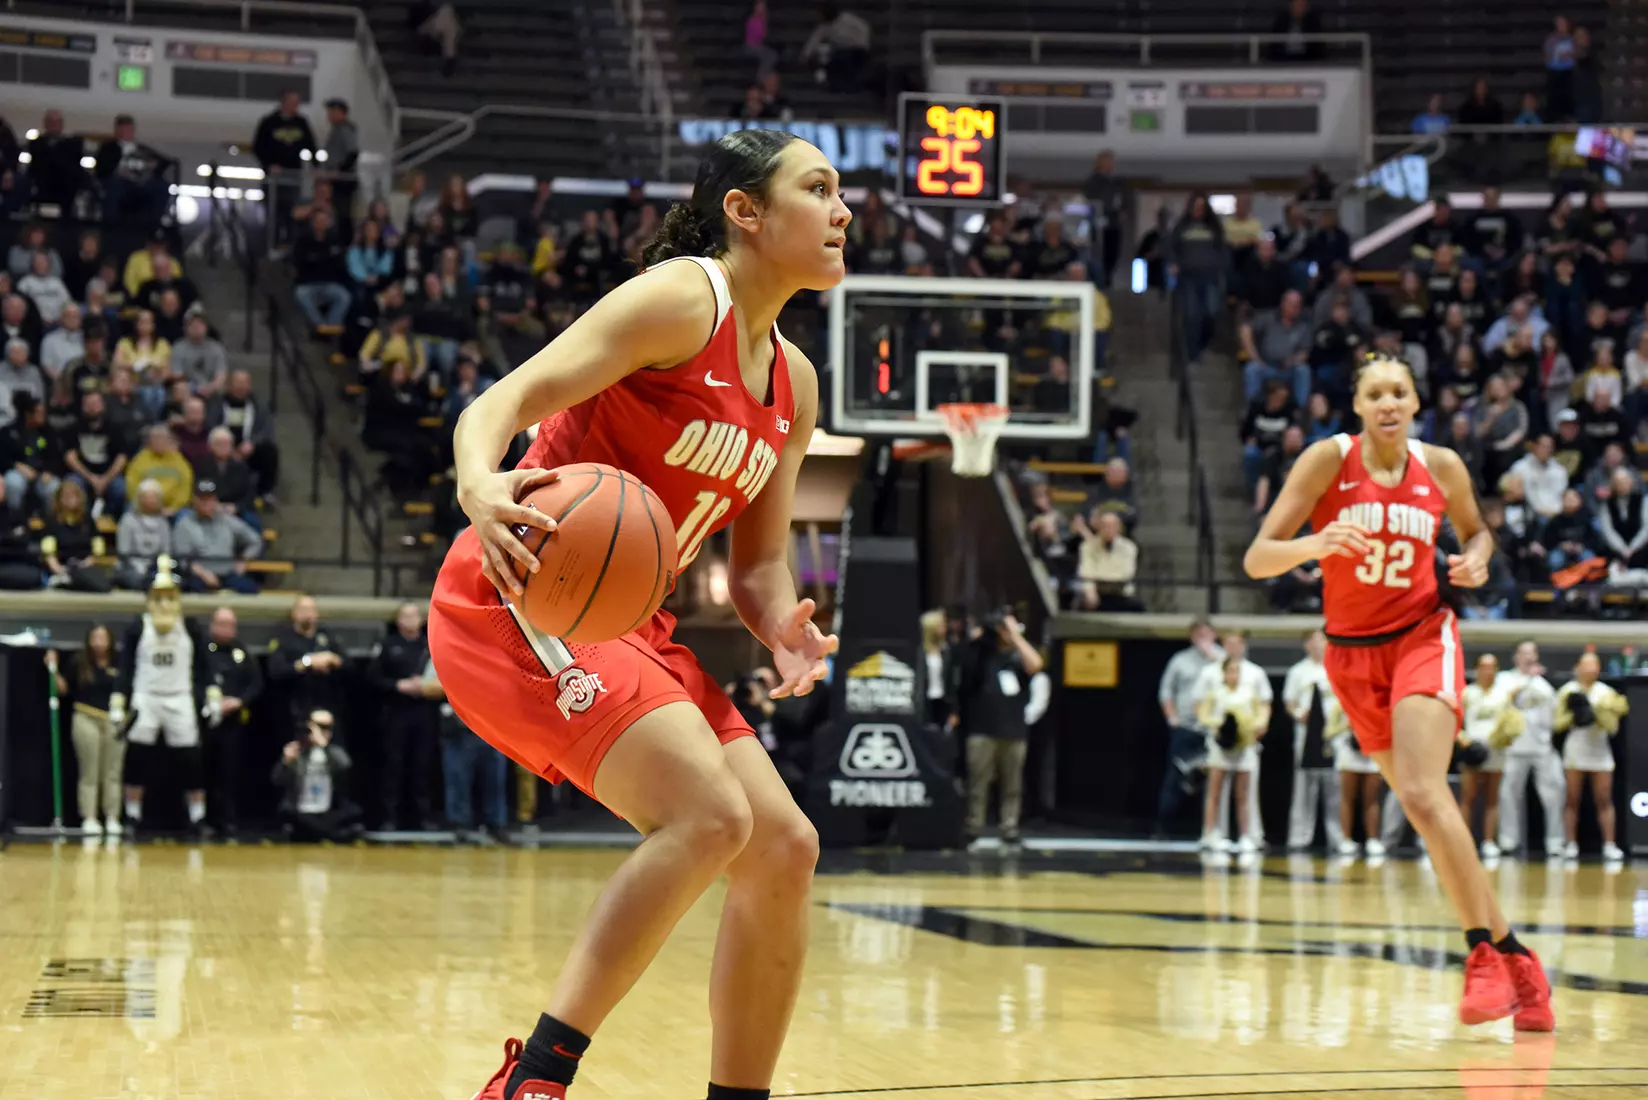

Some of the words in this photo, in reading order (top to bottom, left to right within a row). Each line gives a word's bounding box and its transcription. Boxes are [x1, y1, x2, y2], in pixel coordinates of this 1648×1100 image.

[926, 106, 995, 139] 9:04
[918, 137, 984, 195] 25
[664, 419, 748, 481] OHIO
[1387, 502, 1435, 546] STATE
[1355, 538, 1415, 588] 32
[556, 686, 576, 721] OHIO
[569, 673, 608, 701] STATE
